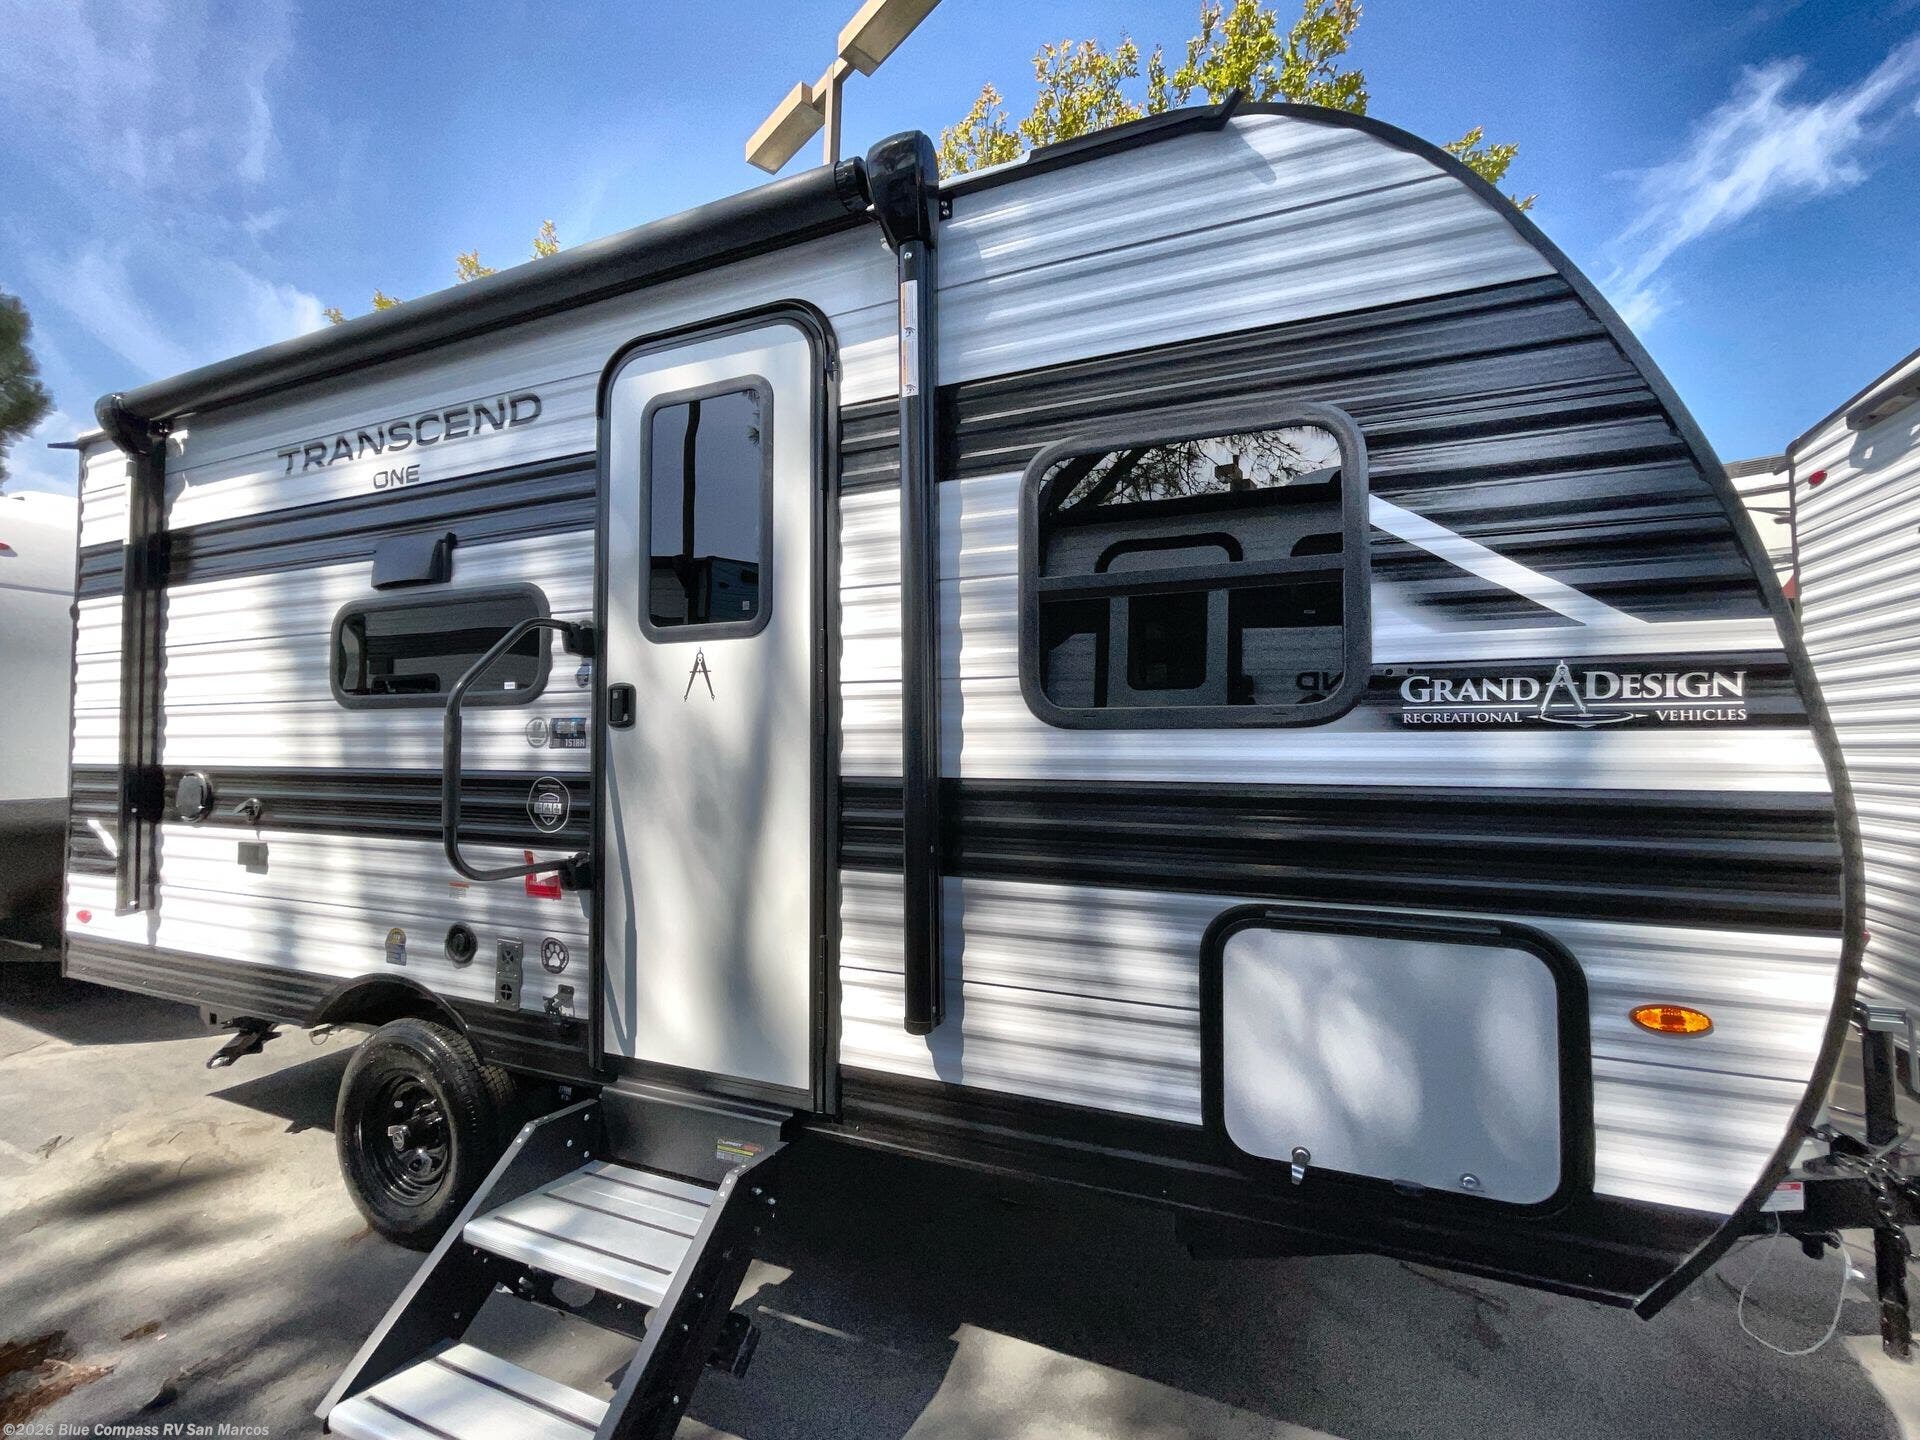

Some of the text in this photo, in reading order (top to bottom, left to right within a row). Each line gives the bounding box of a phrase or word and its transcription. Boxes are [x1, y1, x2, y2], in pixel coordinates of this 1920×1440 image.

[278, 392, 542, 475] TRANSCEND
[373, 464, 420, 489] ONE
[1401, 671, 1747, 703] GRAND DESIGN
[1403, 708, 1747, 724] RECREATIONAL VEHICLES
